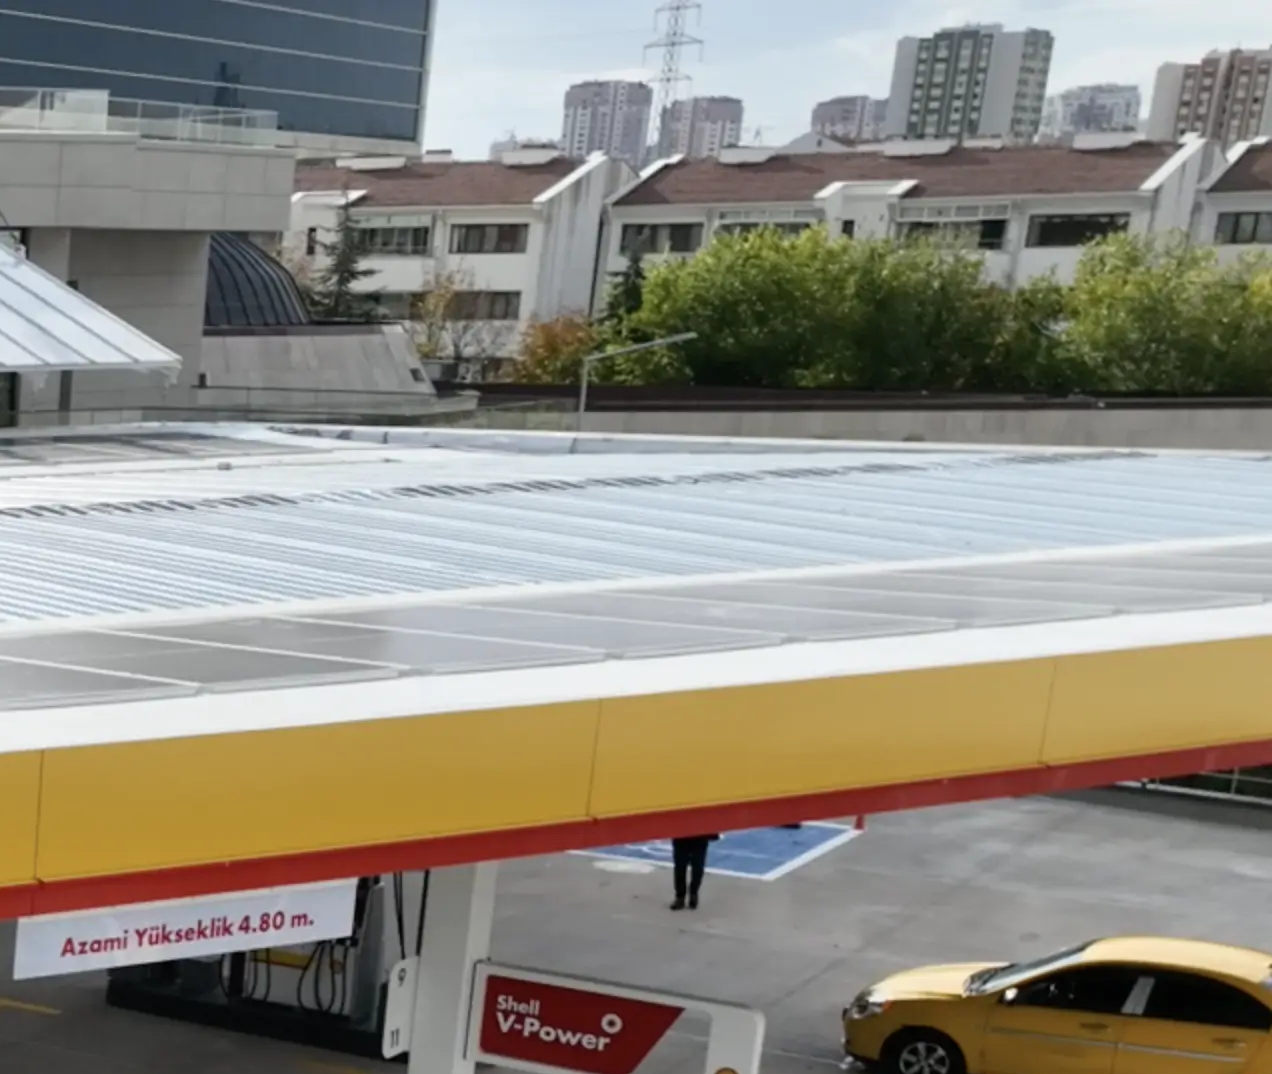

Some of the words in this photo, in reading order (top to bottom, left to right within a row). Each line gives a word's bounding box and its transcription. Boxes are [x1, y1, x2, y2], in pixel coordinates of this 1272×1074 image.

[60, 929, 129, 957] Azami
[134, 916, 235, 948] Yükseklik
[238, 910, 285, 935] 4.80
[290, 912, 315, 928] m.
[397, 967, 407, 988] 9
[496, 994, 540, 1016] Shell
[390, 1028, 400, 1049] 11
[496, 1011, 611, 1052] V-Power
